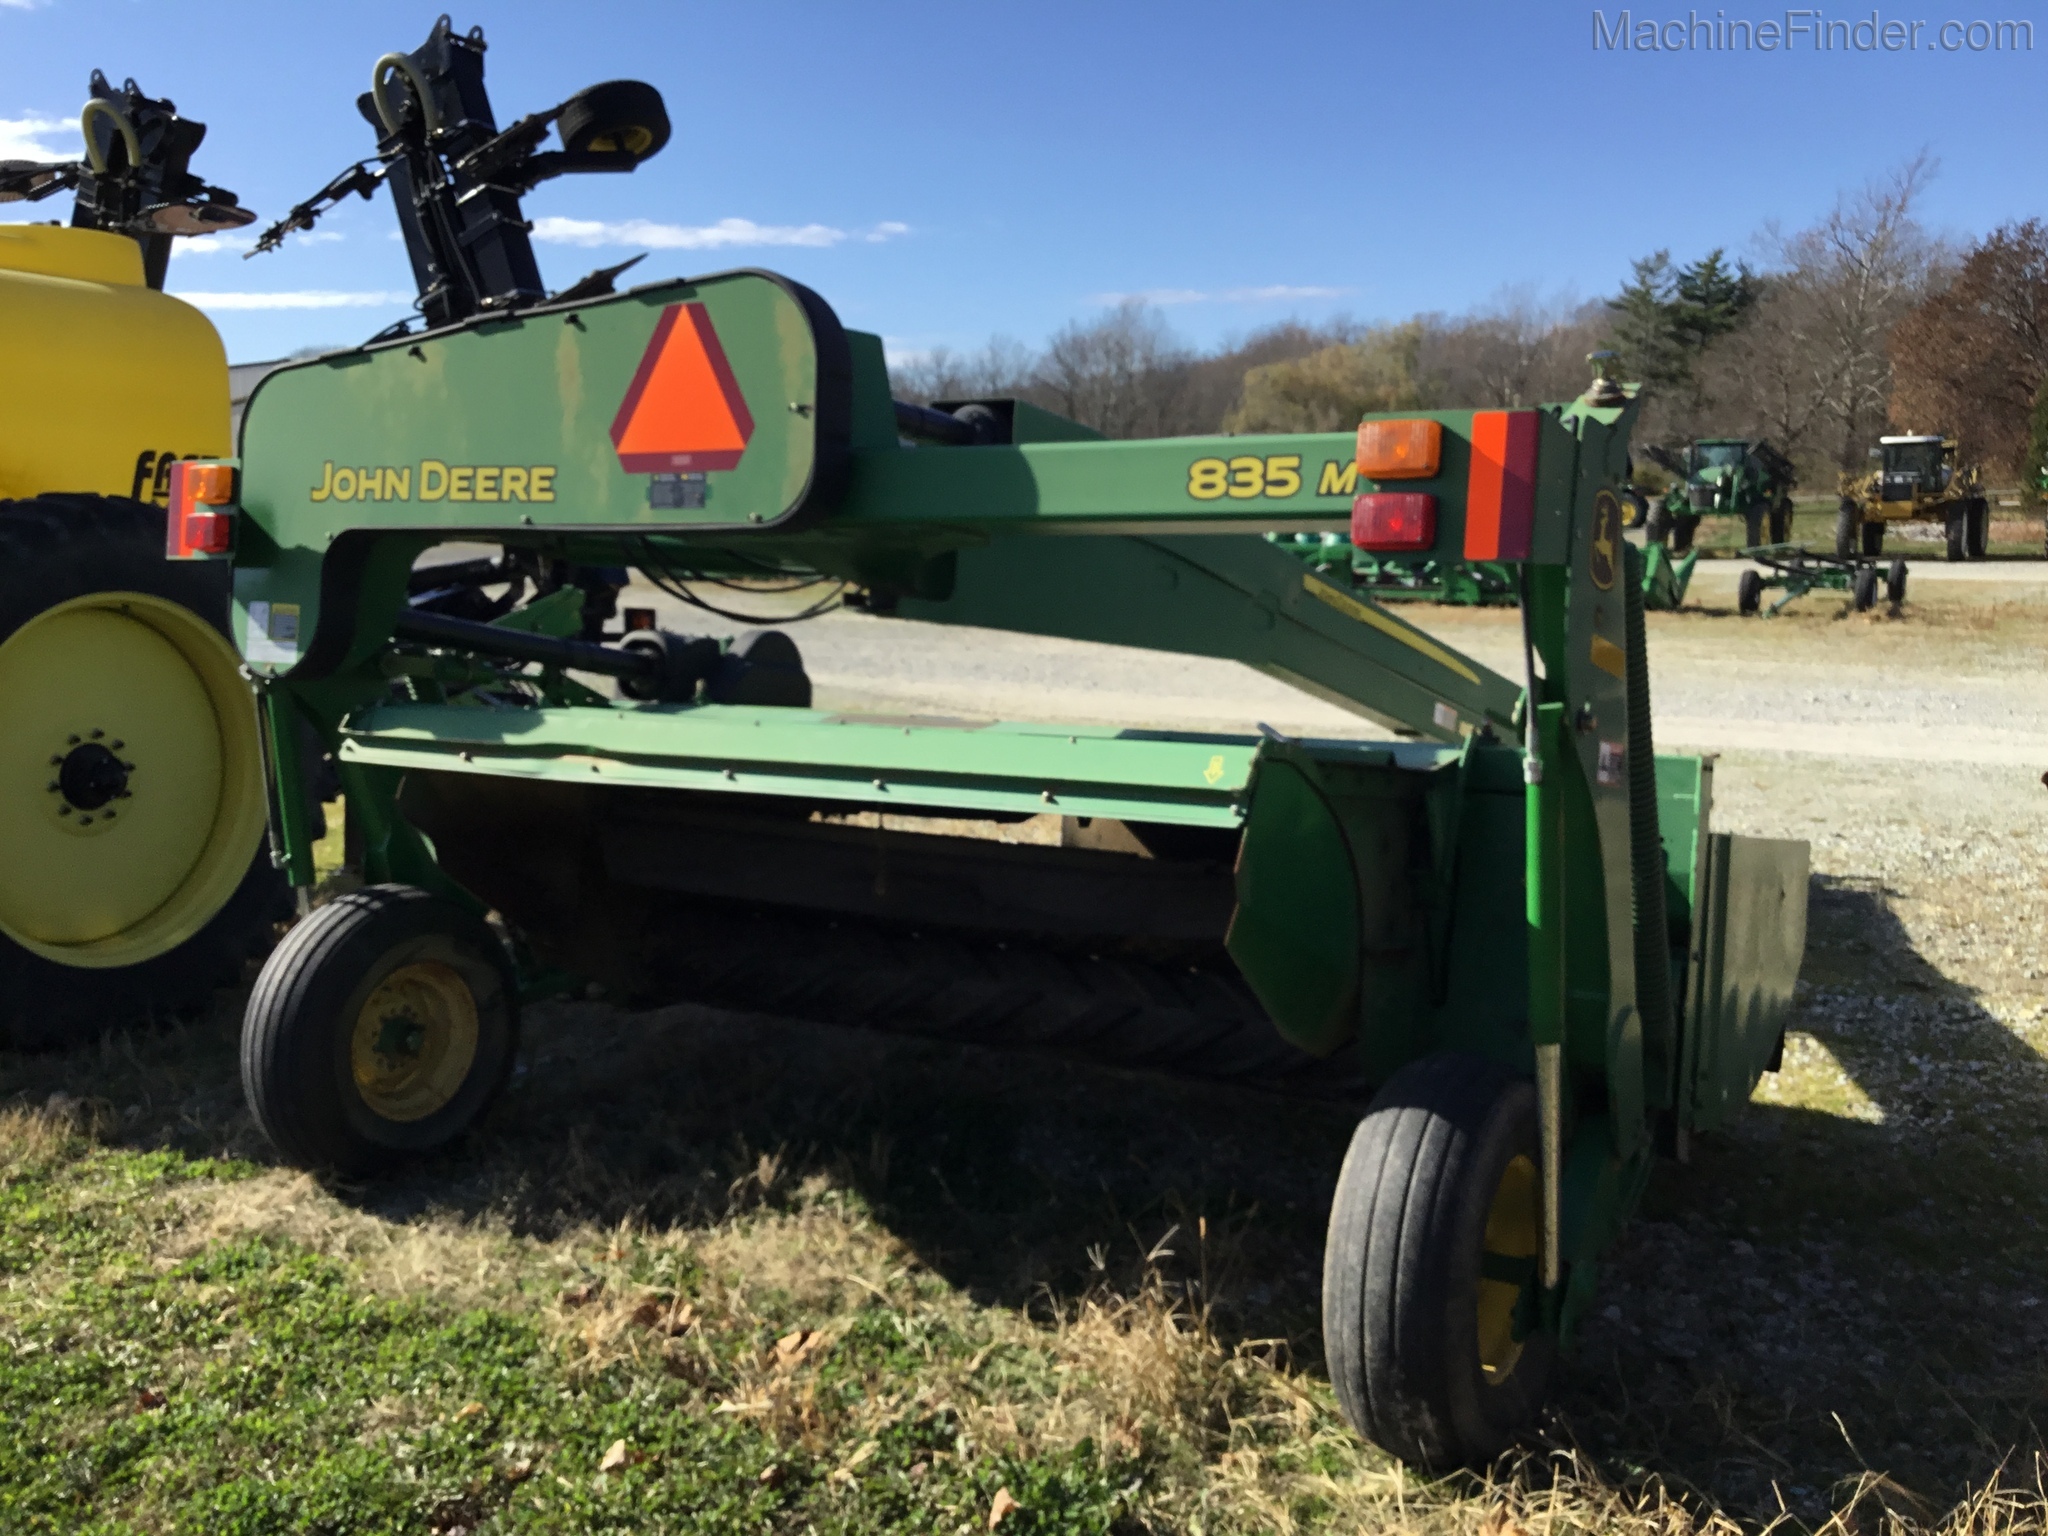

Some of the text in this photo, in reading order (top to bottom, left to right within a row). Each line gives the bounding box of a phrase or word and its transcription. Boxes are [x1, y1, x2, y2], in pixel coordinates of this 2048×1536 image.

[311, 459, 556, 502] JOHN DEERE
[1188, 455, 1301, 500] 835
